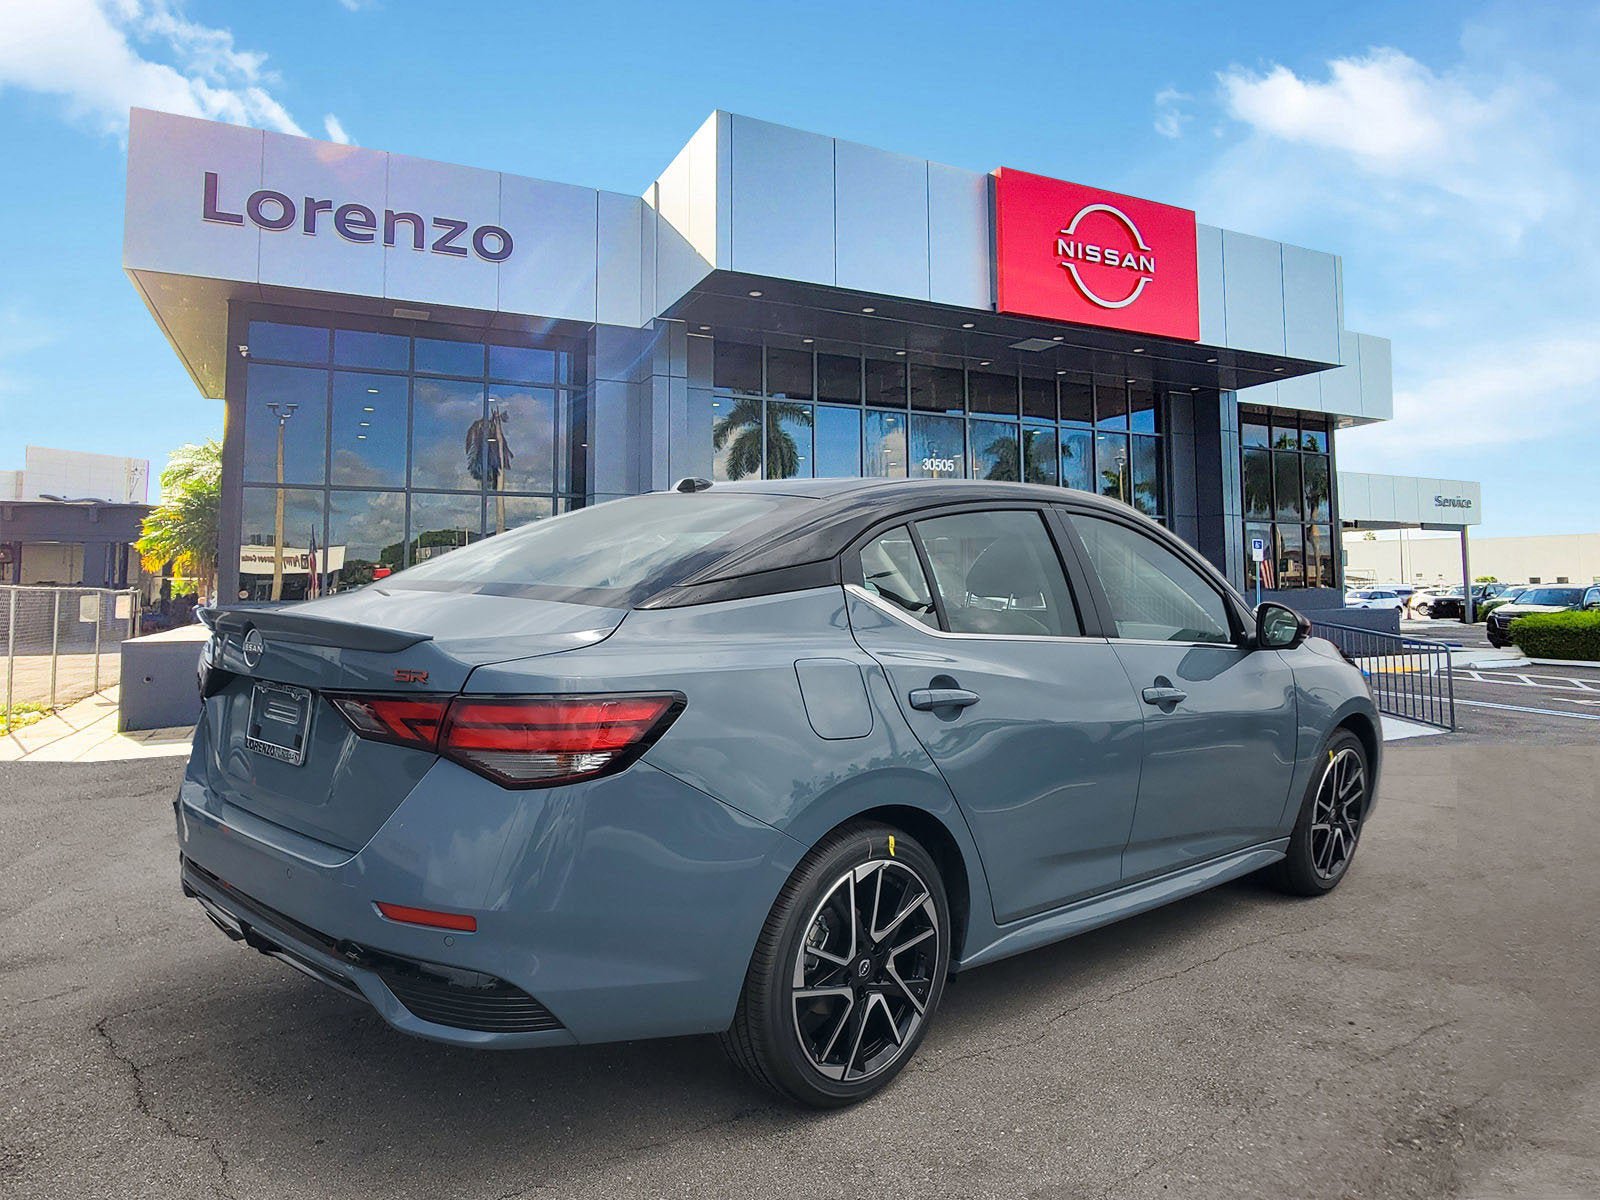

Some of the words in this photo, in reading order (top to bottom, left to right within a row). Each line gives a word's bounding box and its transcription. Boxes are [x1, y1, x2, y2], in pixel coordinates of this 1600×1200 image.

[202, 171, 514, 262] Lorenzo
[1057, 238, 1155, 273] NISSAN
[922, 457, 955, 472] 30505
[1434, 495, 1472, 509] Service
[242, 641, 264, 655] SSAN
[393, 669, 429, 685] SR
